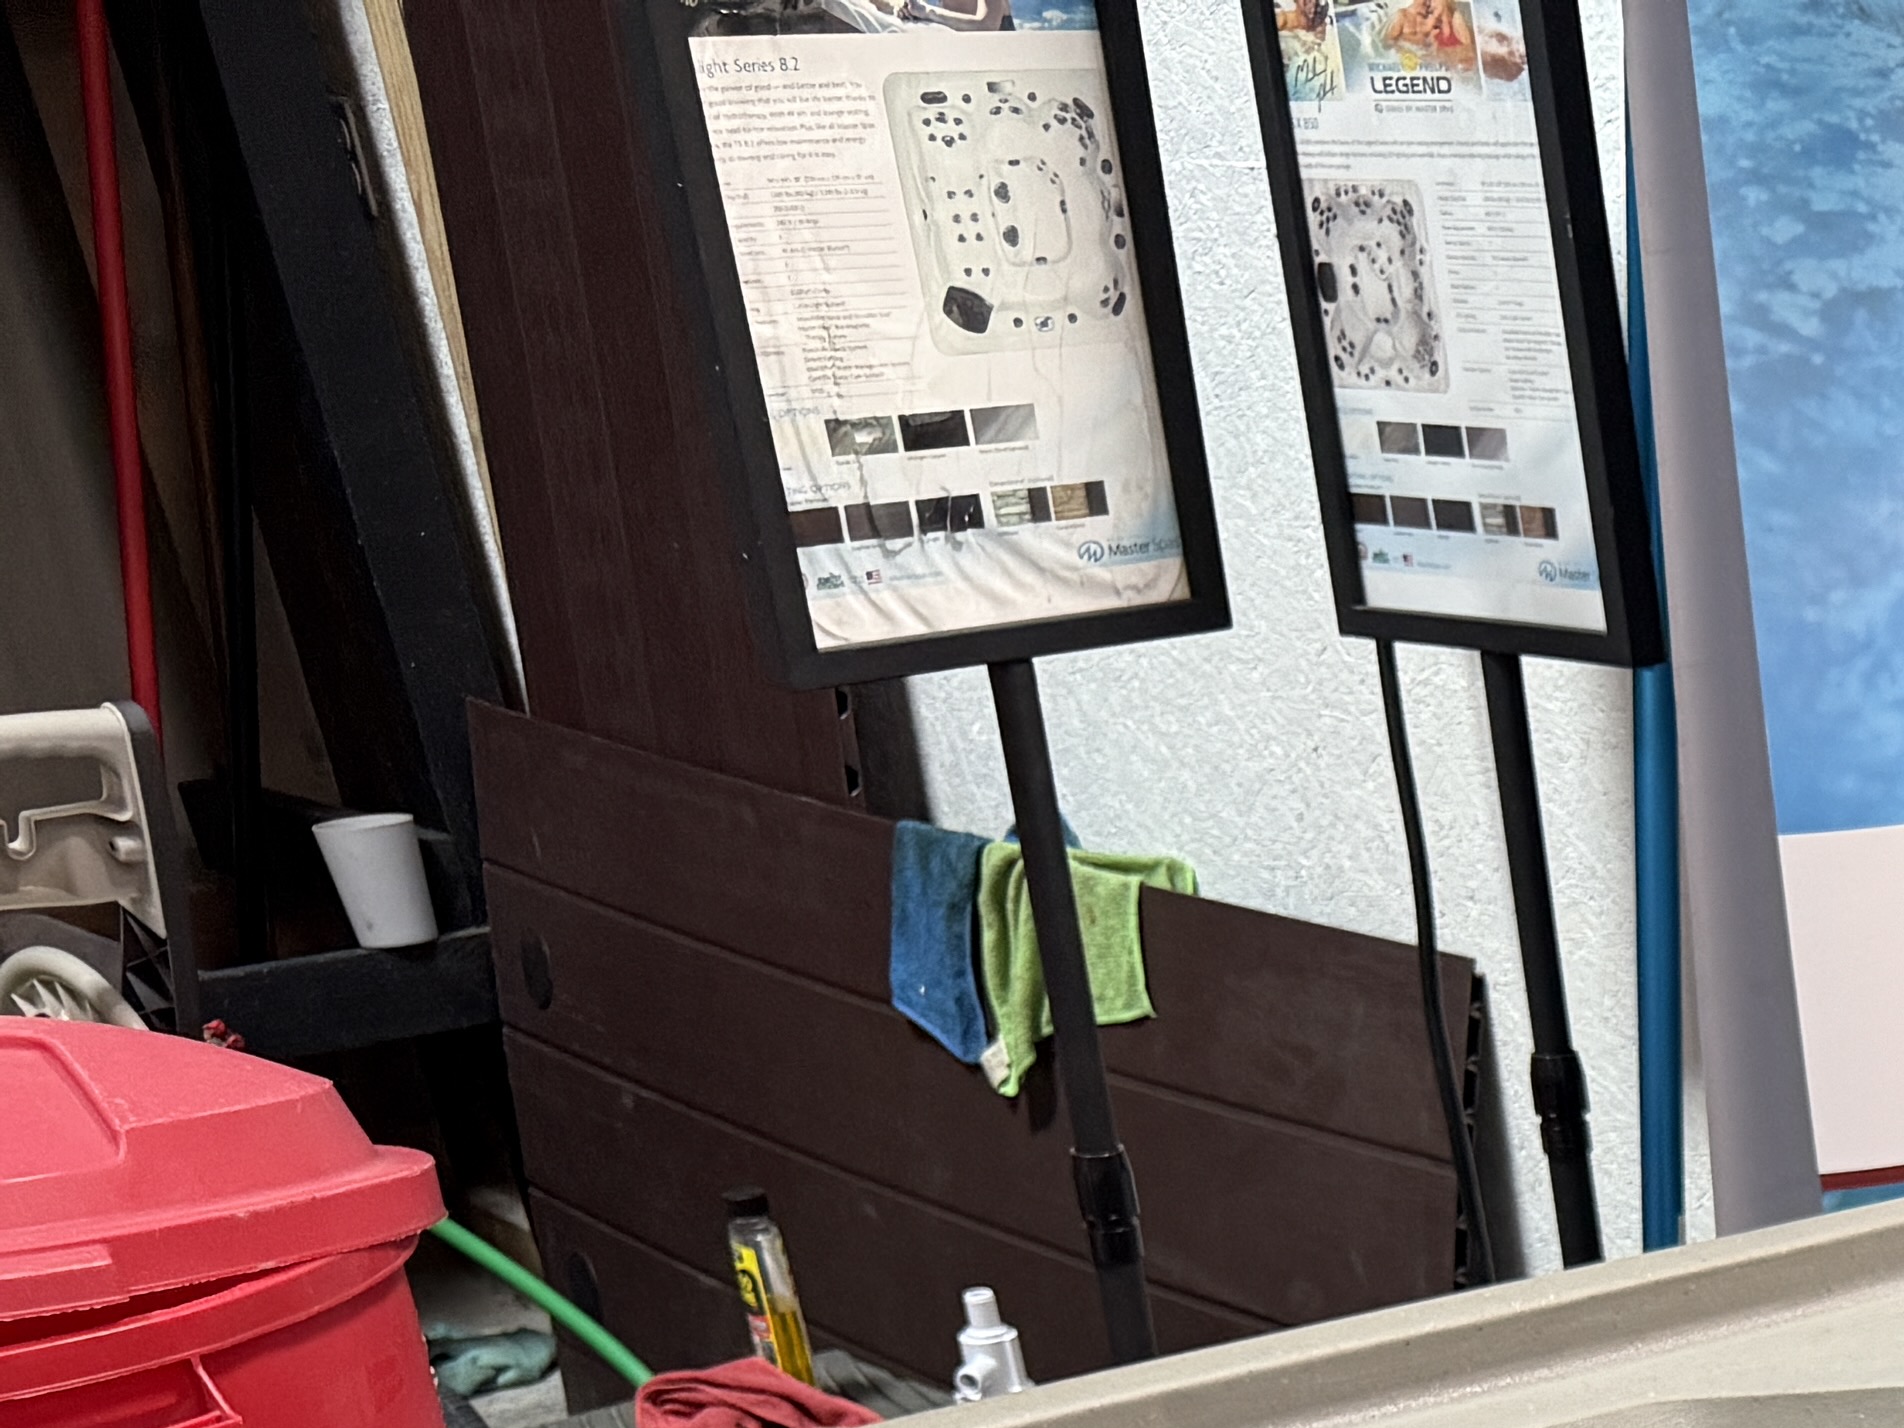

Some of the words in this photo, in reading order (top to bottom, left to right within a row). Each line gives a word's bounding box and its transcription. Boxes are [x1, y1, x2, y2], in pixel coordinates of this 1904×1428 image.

[734, 58, 775, 73] Series
[779, 57, 800, 72] 8.2
[1370, 76, 1452, 94] LEGEND
[1108, 541, 1151, 557] Master
